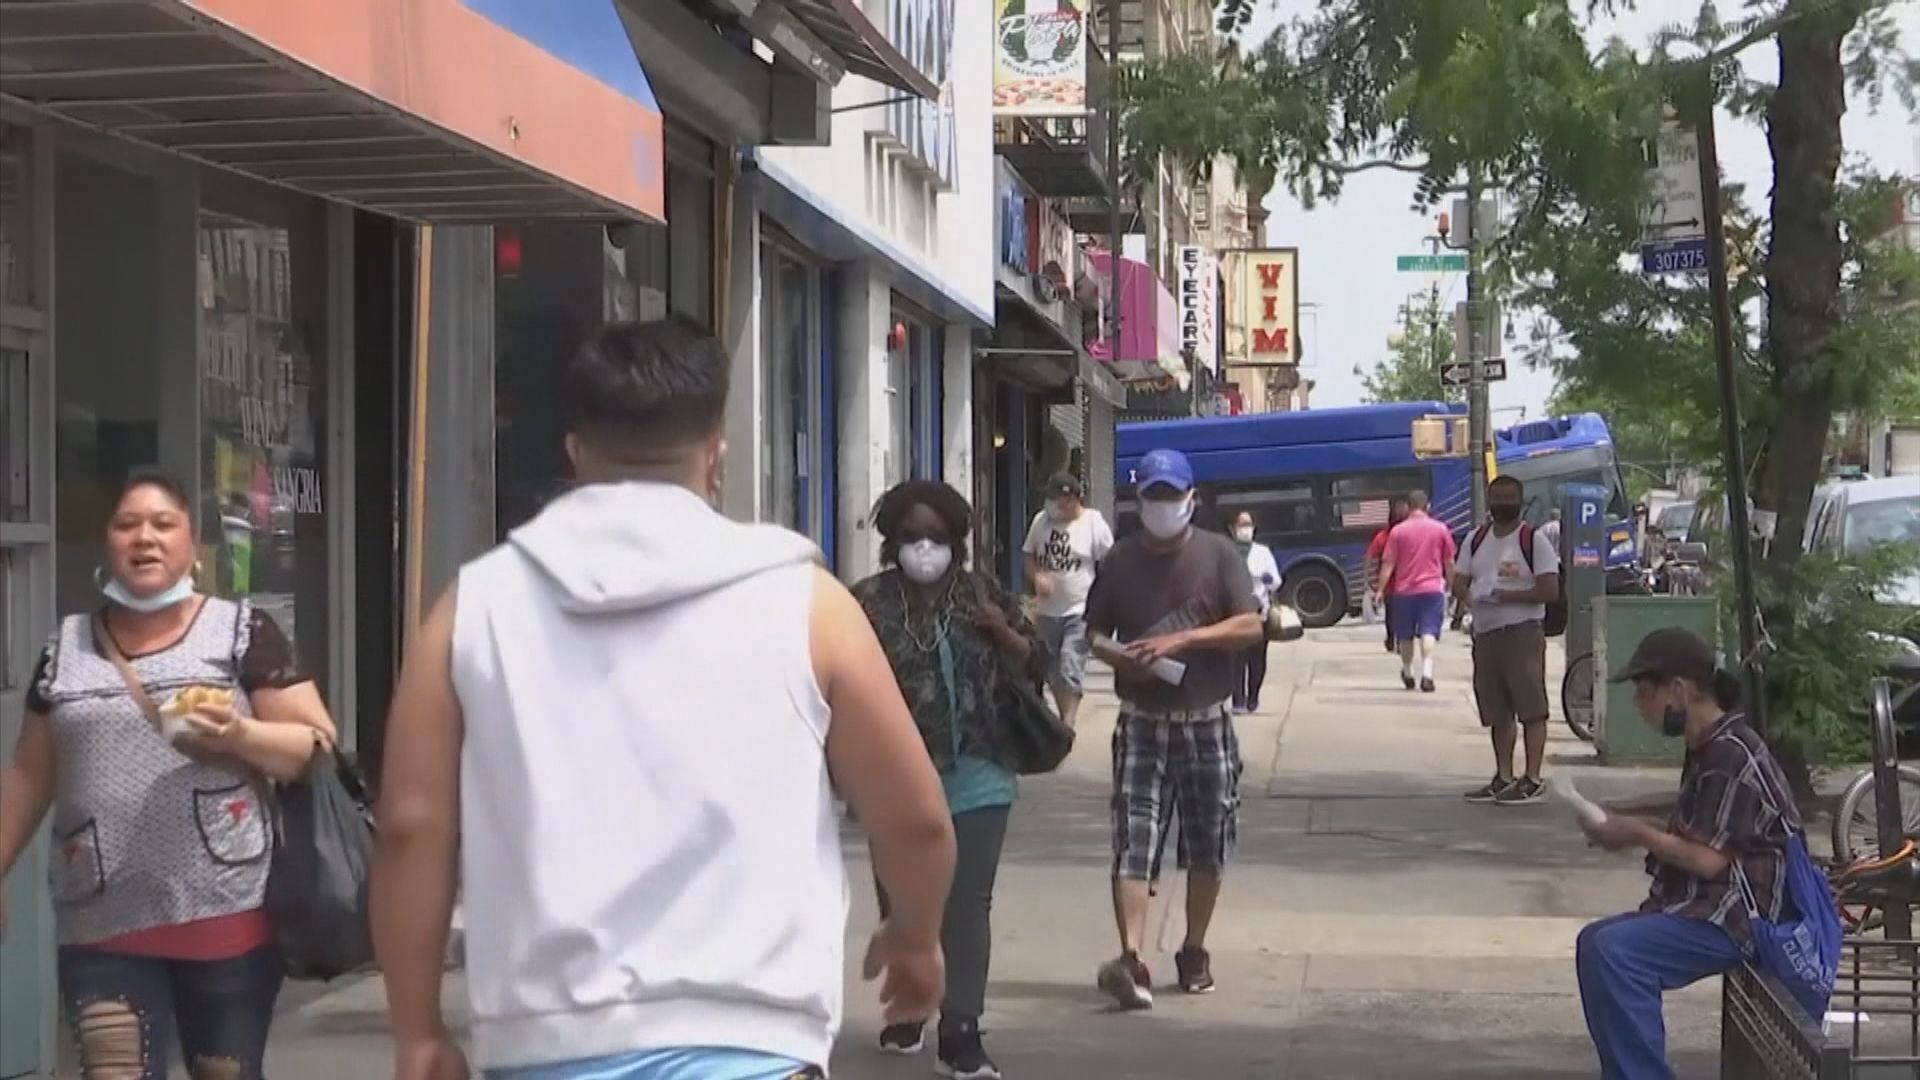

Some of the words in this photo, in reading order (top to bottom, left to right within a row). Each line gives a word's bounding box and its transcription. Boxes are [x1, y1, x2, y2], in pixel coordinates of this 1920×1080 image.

[1655, 249, 1705, 270] 307375
[1252, 263, 1288, 353] VIM
[274, 467, 322, 513] SANGRIA
[1582, 502, 1597, 524] P
[1050, 529, 1070, 543] DO
[1044, 542, 1071, 557] YOU
